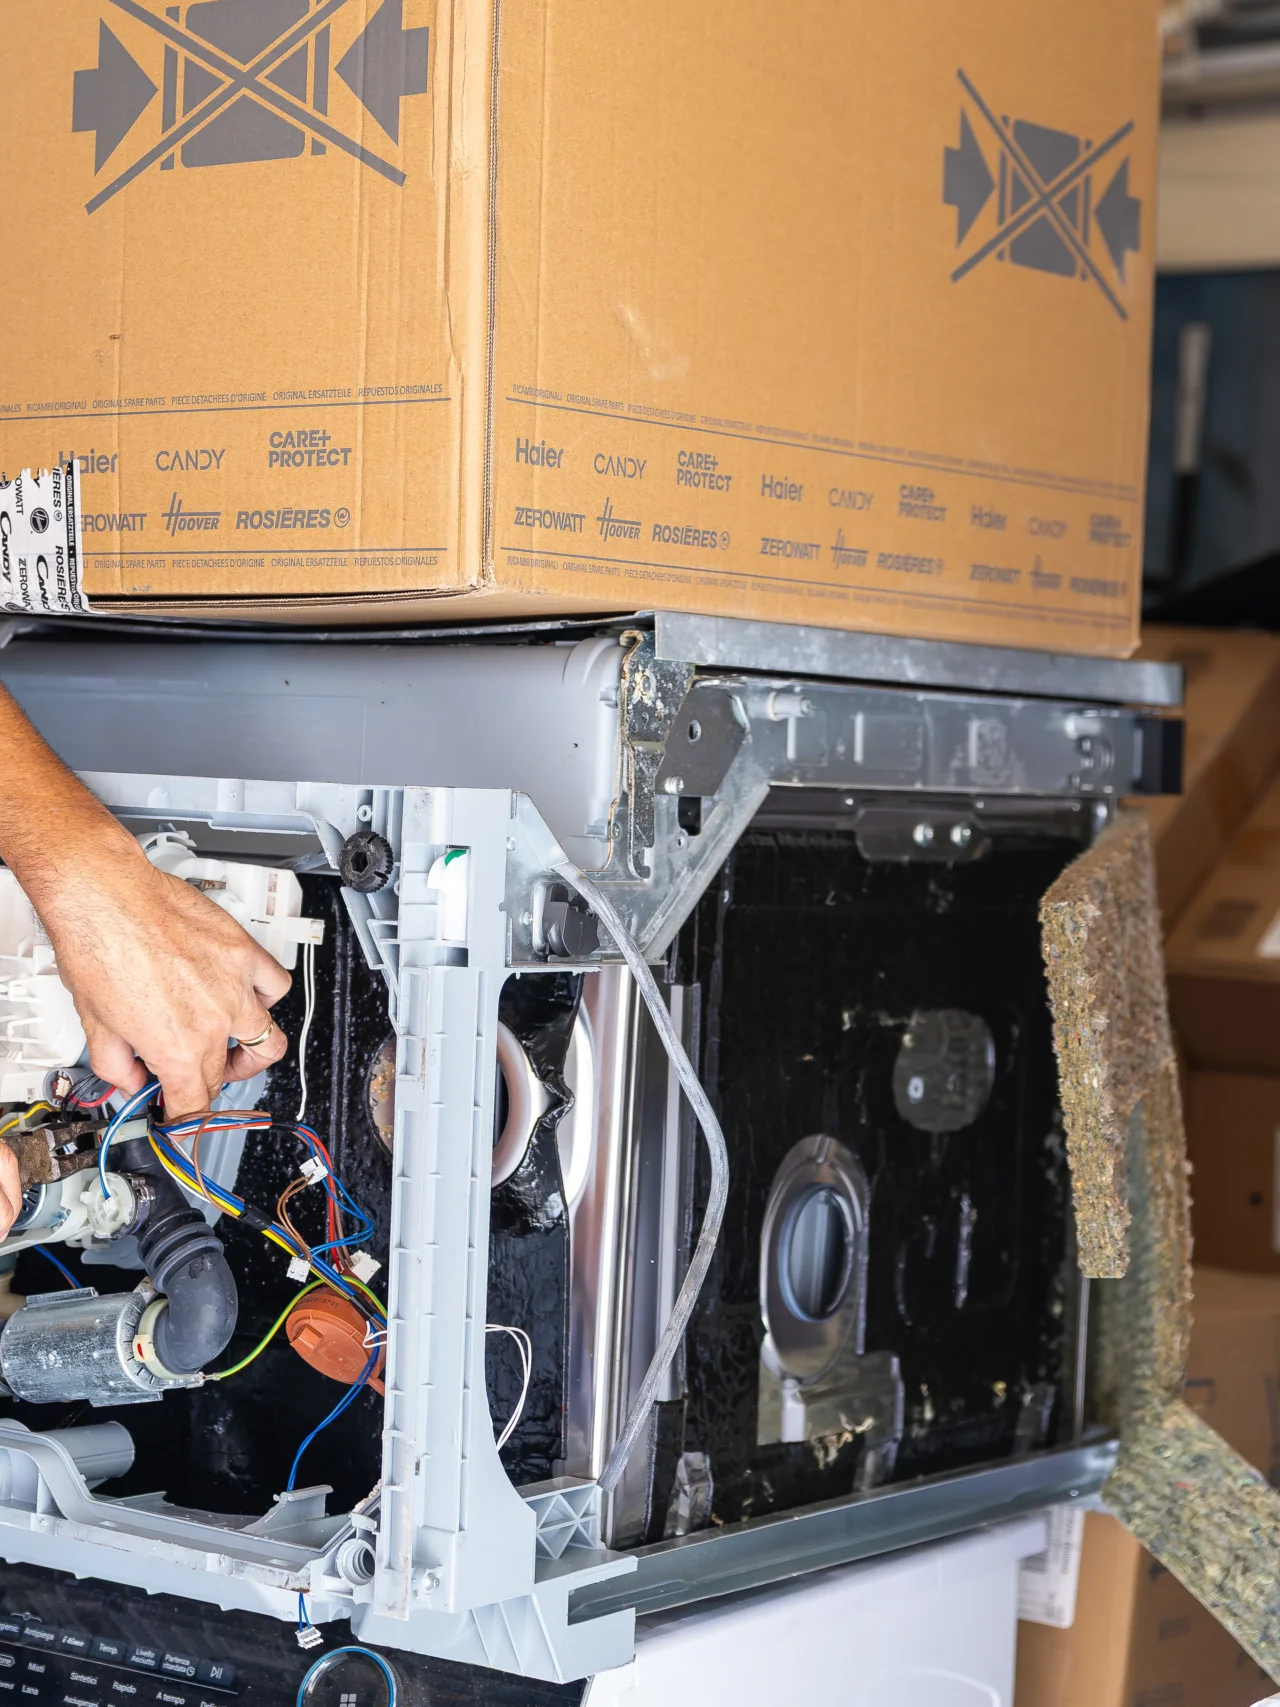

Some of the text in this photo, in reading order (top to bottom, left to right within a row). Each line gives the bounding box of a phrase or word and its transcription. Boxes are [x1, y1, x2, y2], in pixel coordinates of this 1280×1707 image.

[171, 392, 266, 405] PIECE DETACHEES D'ORIGINE
[273, 388, 351, 401] ORIGINAL ERSATZTEILE
[358, 383, 443, 397] REPUESTOS ORIGINALES
[26, 400, 86, 412] RICAMBI ORIGINALI
[92, 396, 165, 409] ORIGINAL SPARE PARTS
[269, 429, 331, 448] CARE+
[59, 449, 118, 474] Haier
[155, 448, 226, 471] CANDY
[269, 447, 352, 468] PROTECT
[516, 437, 563, 468] Haier
[593, 452, 647, 479] CANDY
[677, 468, 732, 492] PROTECT
[760, 474, 804, 503] Haier
[15, 477, 24, 515] OWATT
[66, 475, 74, 506] ORIGINAL
[828, 487, 874, 512] CANDY
[67, 506, 75, 547] ERSATZTEILE
[80, 513, 147, 532] EROWATT
[514, 506, 586, 533] ZEROWATT
[759, 537, 821, 561] ZEROWATT
[94, 559, 166, 569] ORIGINAL SPARE PARTS
[172, 558, 265, 568] PIECE DETACHEES D'ORIGINE
[271, 557, 348, 567] ORIGINAL ERSATZTEILE
[354, 556, 438, 567] REPUESTOS ORIGINALES
[562, 561, 588, 573] ORIGINAL
[70, 1671, 98, 1685] Sintetici
[112, 1681, 137, 1694] Rapido
[21, 1684, 39, 1696] Lana
